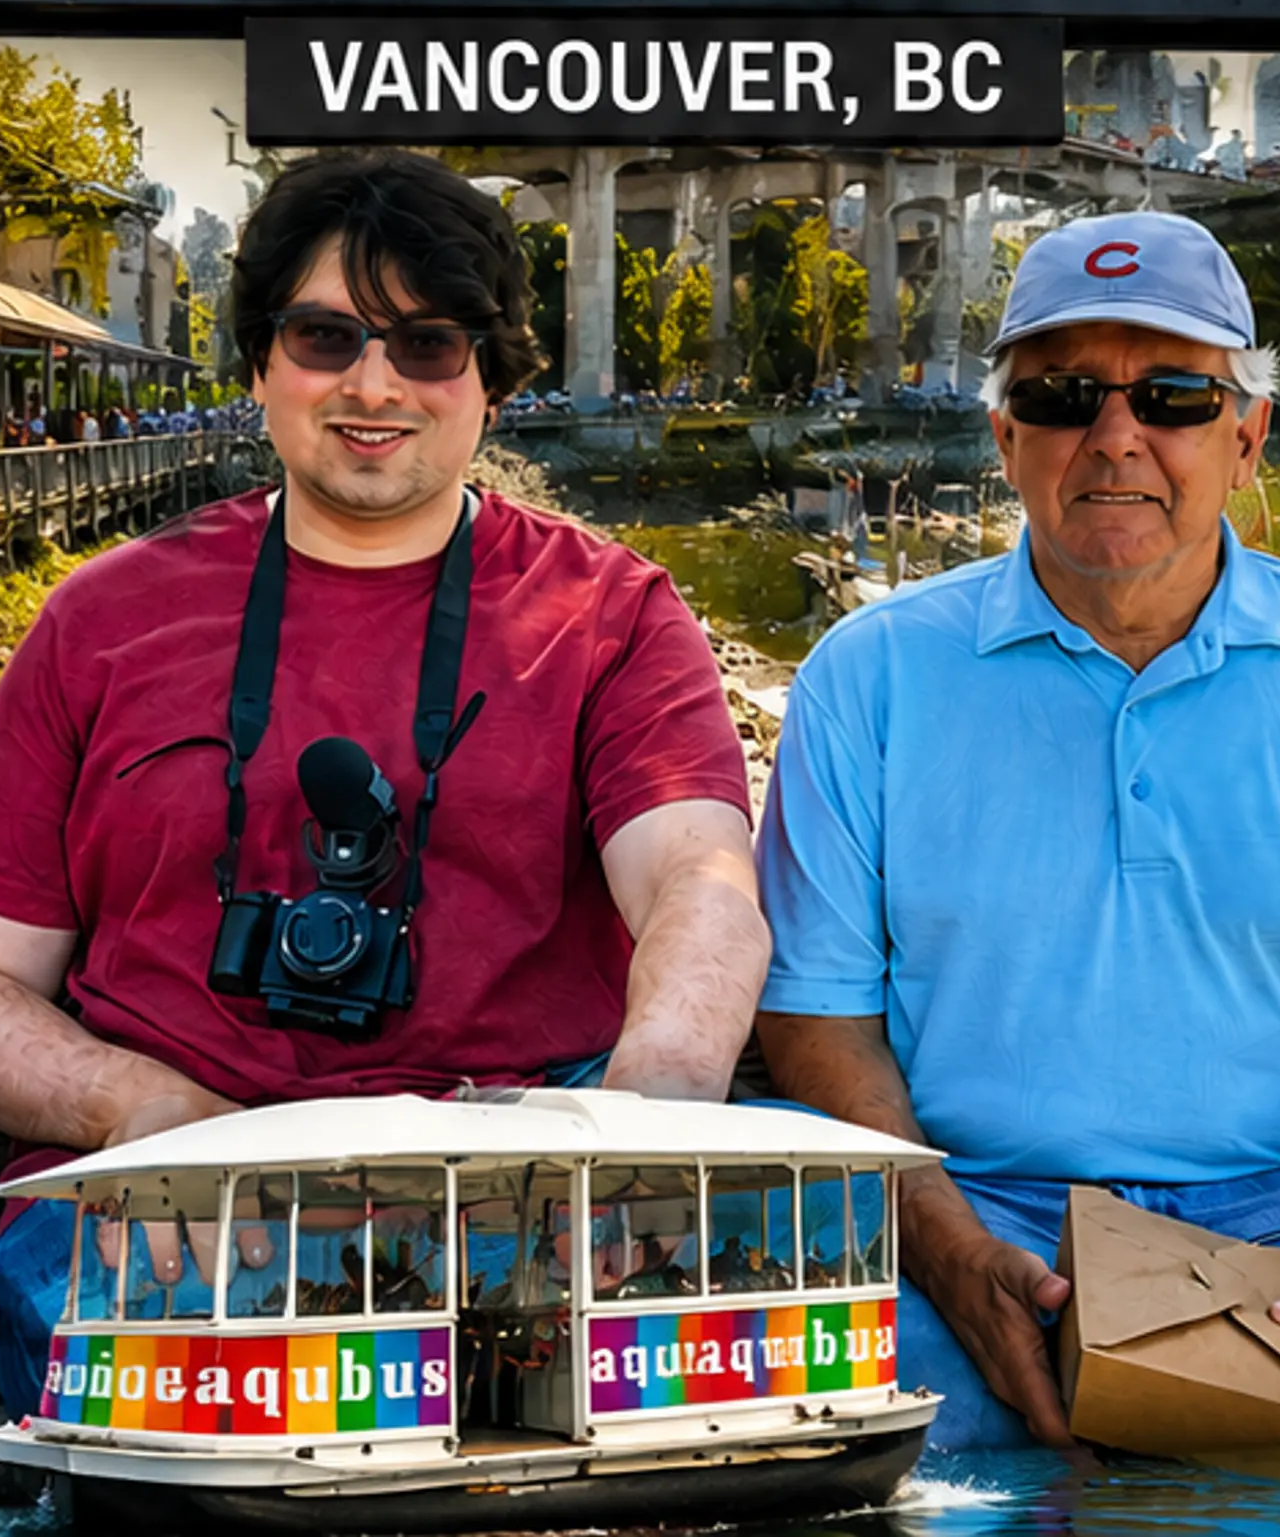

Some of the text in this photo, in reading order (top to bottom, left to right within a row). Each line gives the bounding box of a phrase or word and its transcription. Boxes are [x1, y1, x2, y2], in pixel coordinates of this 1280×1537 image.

[309, 40, 1004, 125] VANCOUVER, BC
[1084, 241, 1141, 279] C
